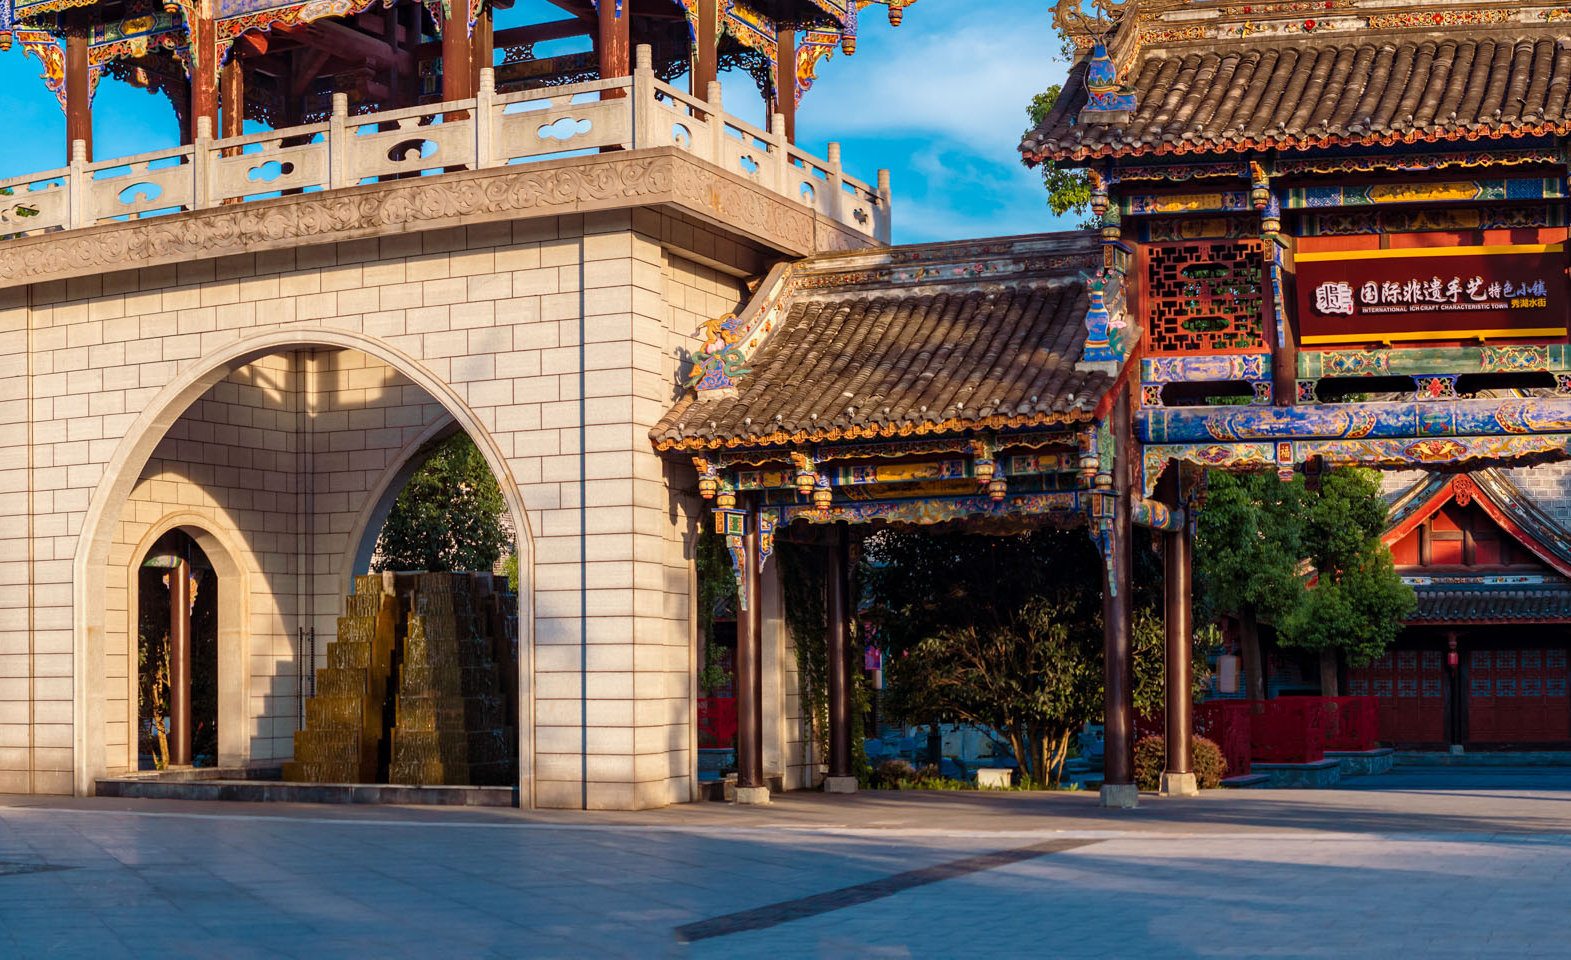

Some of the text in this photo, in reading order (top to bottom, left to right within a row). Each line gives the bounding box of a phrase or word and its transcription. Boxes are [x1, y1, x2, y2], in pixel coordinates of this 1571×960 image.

[1440, 303, 1490, 311] CHARACTERISTIC
[1491, 302, 1509, 310] TOWN
[1511, 298, 1547, 309] 秀湖水街
